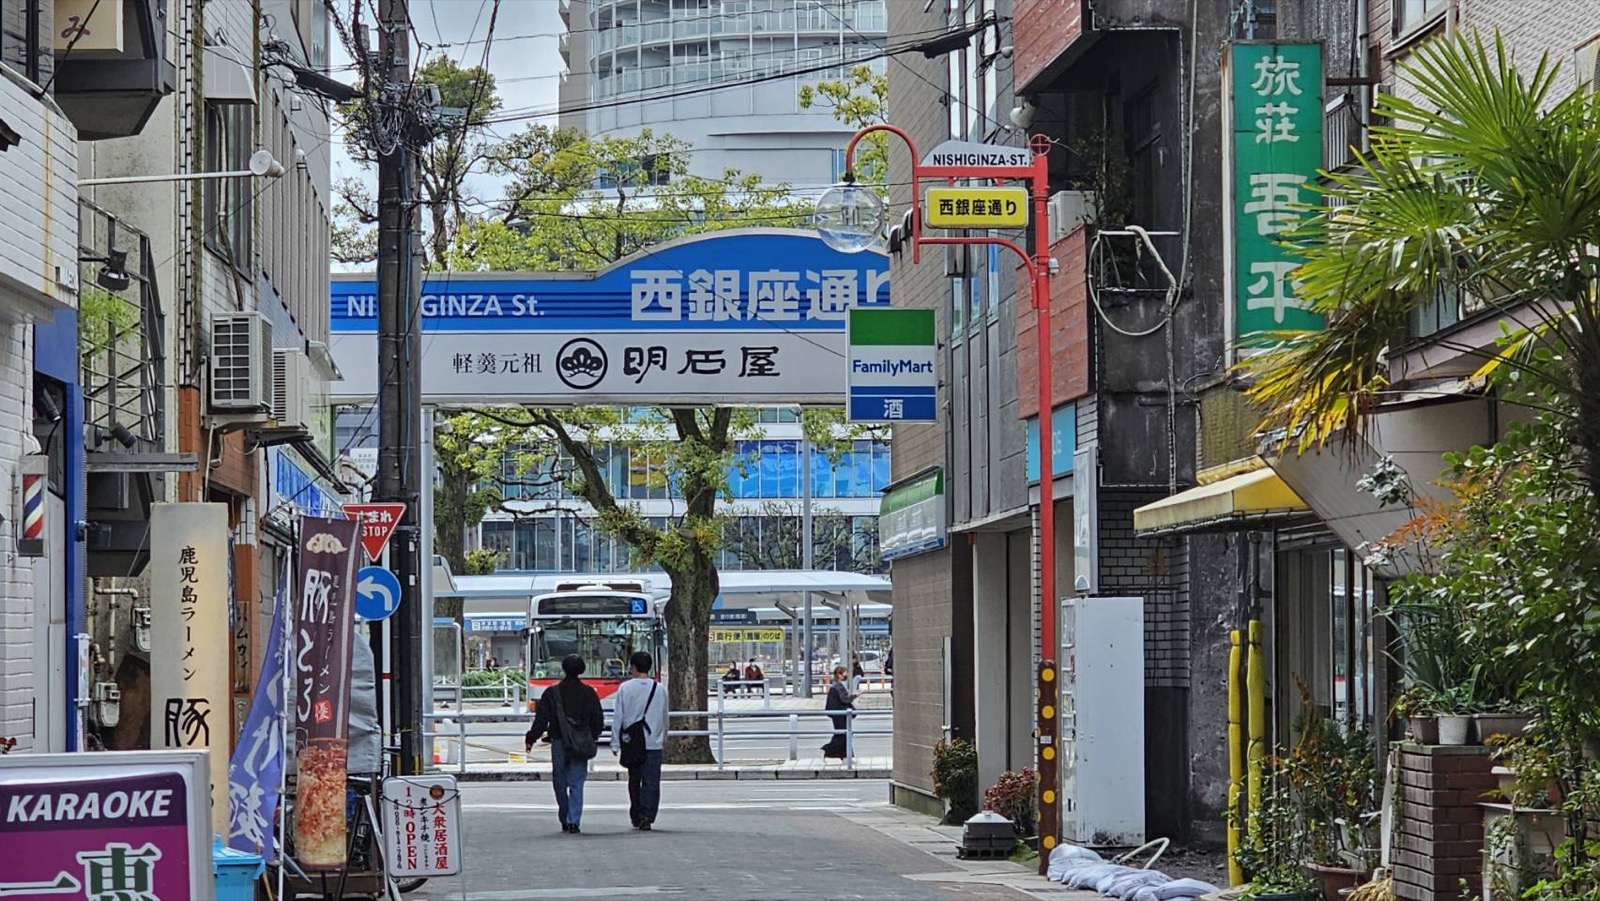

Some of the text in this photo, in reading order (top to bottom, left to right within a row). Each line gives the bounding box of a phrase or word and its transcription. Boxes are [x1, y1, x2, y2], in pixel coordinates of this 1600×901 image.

[933, 153, 1029, 167] NISHIGINZA-ST.
[939, 198, 1018, 218] 西銀座通り
[347, 294, 546, 317] NIGINZA St.
[623, 345, 781, 383] 明石屋
[853, 358, 933, 377] FamilyMart
[883, 398, 904, 419] 酒
[362, 526, 388, 537] STOP
[178, 545, 199, 681] 鹿児島ラーメン
[297, 568, 332, 722] 豚とろ
[6, 789, 173, 822] KARAOKE
[432, 802, 449, 870] 大衆居酒屋
